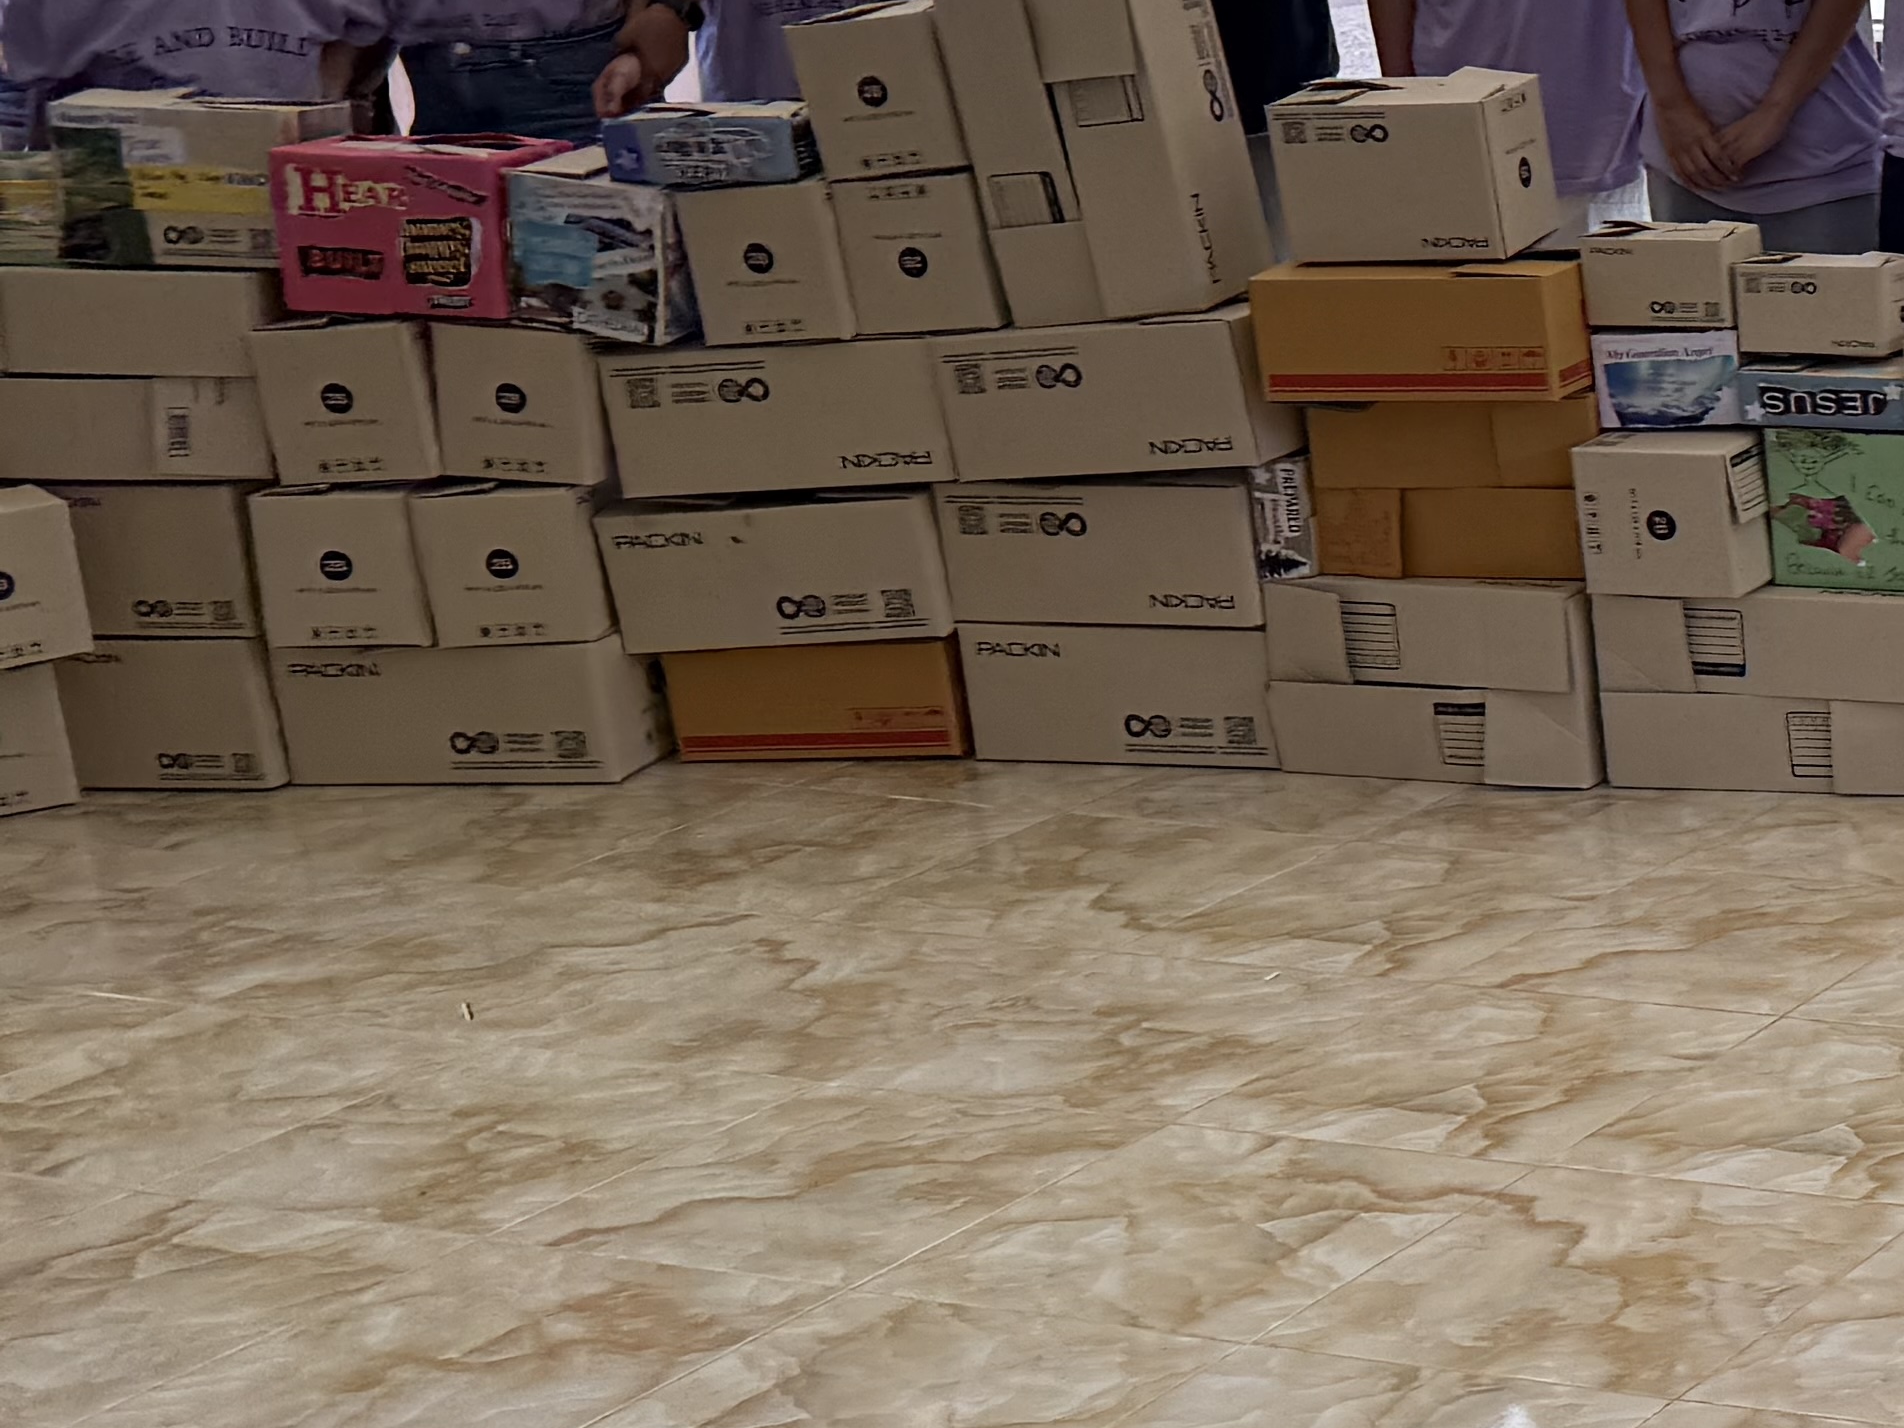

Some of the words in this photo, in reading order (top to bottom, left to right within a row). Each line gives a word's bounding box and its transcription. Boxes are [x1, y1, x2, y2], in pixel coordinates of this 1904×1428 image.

[154, 26, 215, 55] AND
[1763, 390, 1885, 417] JESUS
[974, 639, 1061, 659] PACKIN
